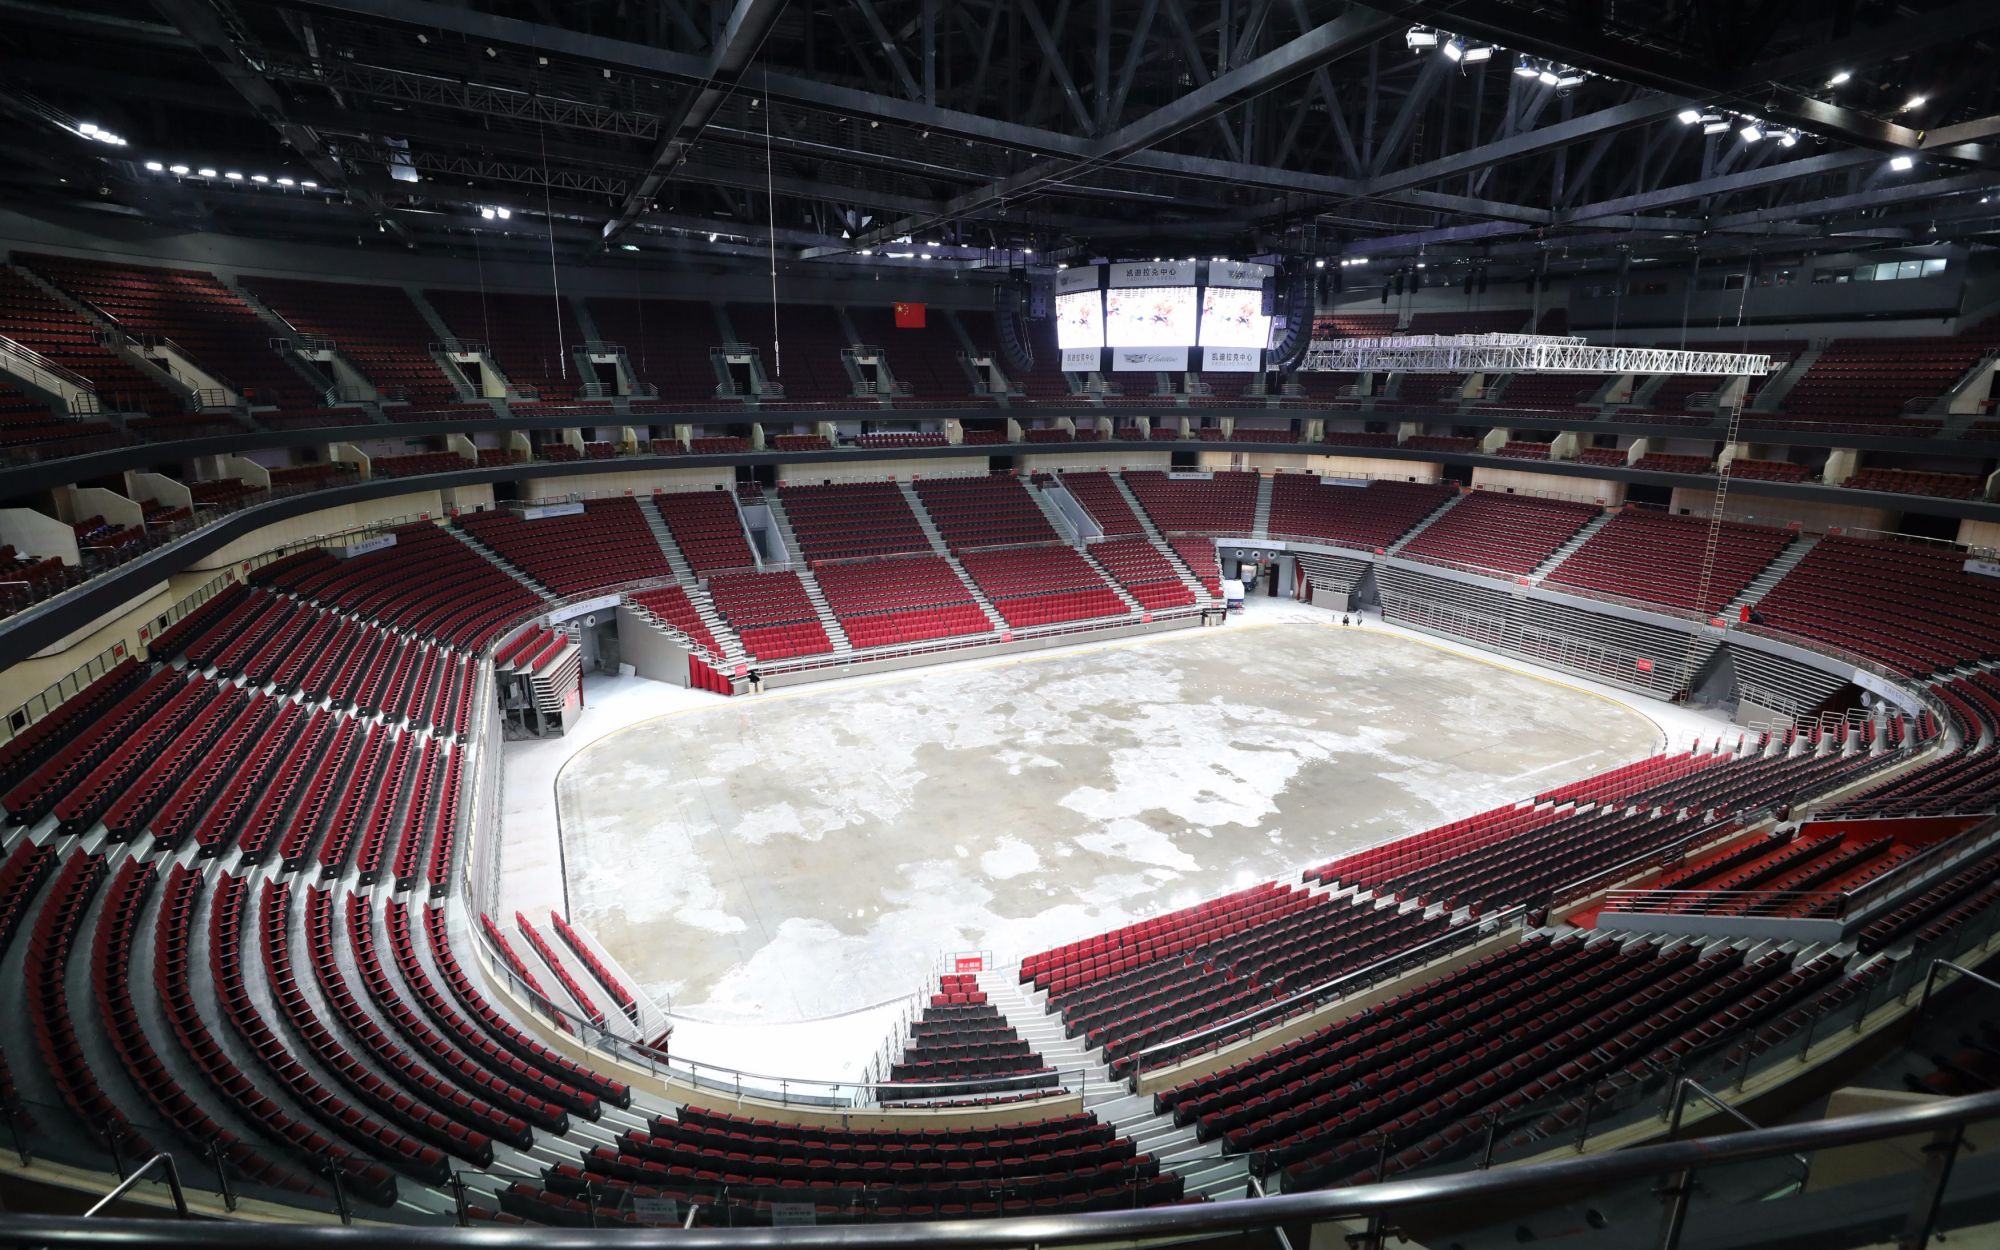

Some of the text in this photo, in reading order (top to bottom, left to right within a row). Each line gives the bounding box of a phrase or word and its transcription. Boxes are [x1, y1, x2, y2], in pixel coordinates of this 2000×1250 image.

[1211, 353, 1253, 362] 凯迪拉克中心
